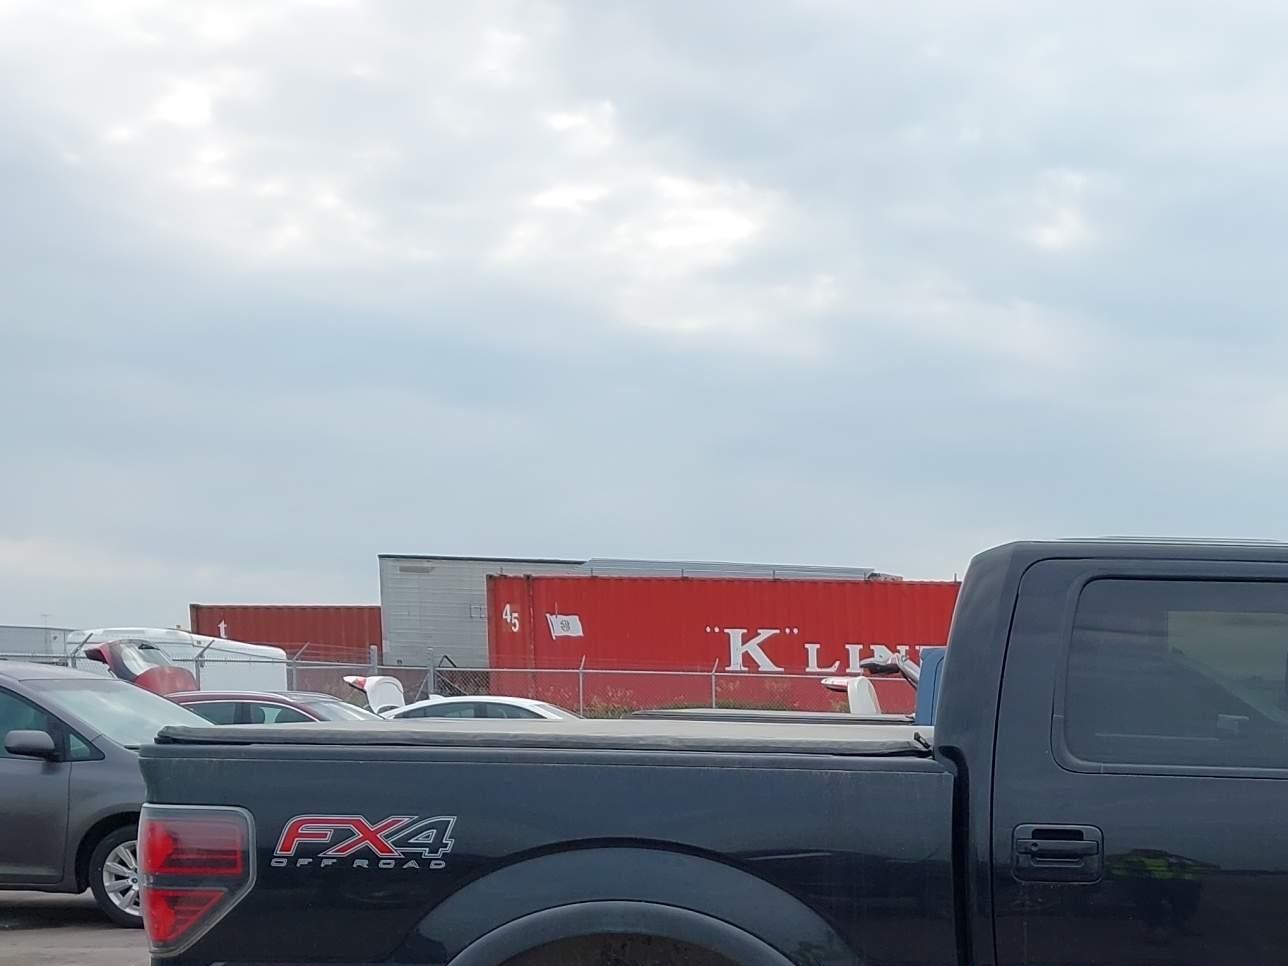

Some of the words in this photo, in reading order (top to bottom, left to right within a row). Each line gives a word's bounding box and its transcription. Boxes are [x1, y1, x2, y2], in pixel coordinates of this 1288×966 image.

[502, 603, 520, 633] 45
[273, 815, 457, 858] FX4
[270, 858, 337, 867] OFF
[352, 859, 446, 869] ROAD
